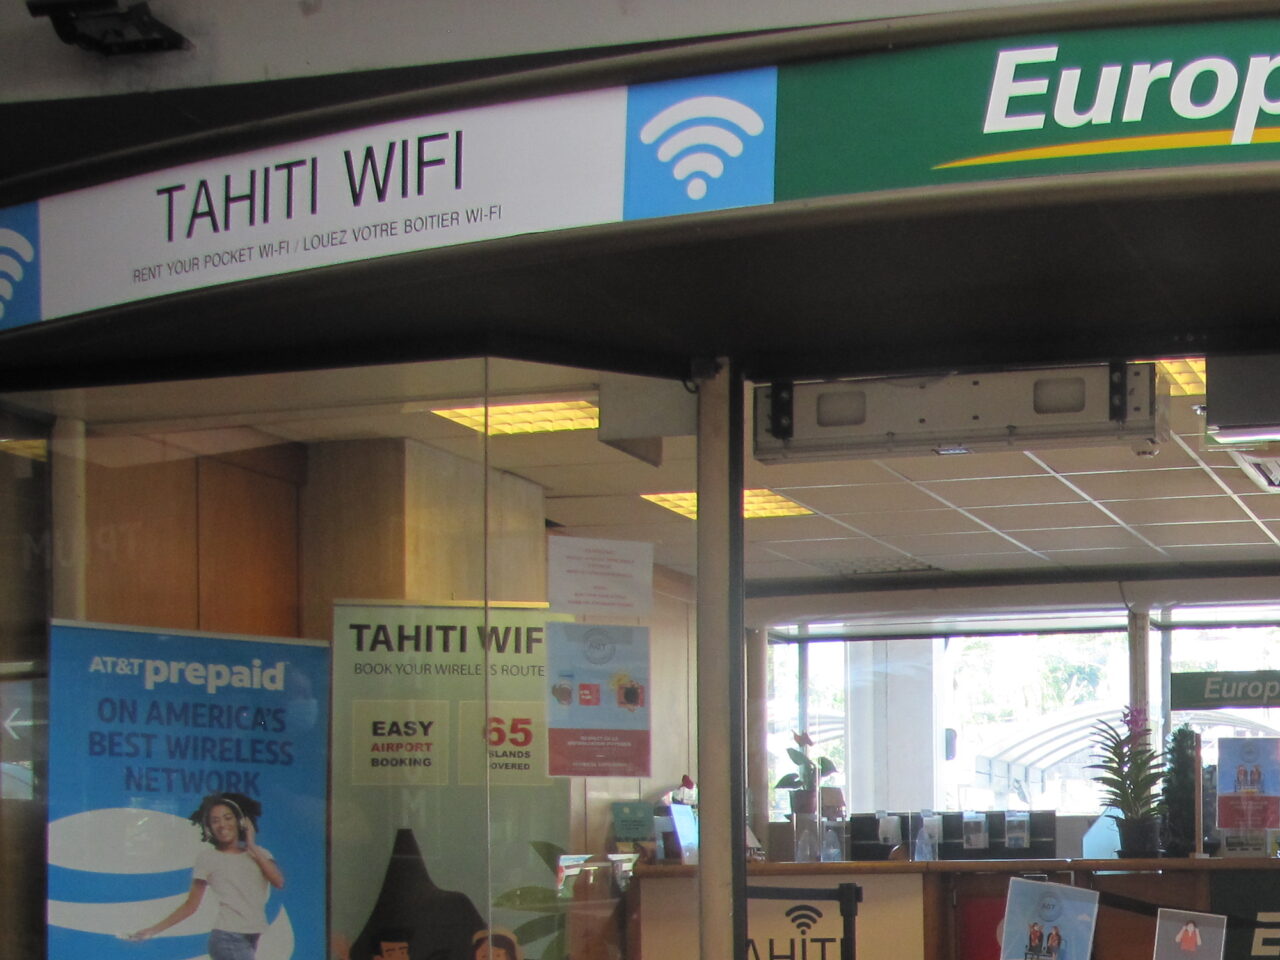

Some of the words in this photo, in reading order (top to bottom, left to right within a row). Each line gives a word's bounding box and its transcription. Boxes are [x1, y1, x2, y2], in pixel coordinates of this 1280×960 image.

[156, 156, 319, 243] TAHITI
[343, 130, 464, 207] WIFI
[132, 263, 163, 284] RENT
[166, 256, 200, 277] YOUR
[203, 246, 255, 269] POCKET
[258, 239, 291, 260] WI-FI
[302, 229, 348, 252] LOUEZ
[352, 220, 399, 244] VOTRE
[403, 210, 461, 235] BOITIER
[464, 203, 503, 225] WI-FI
[349, 623, 468, 653] TAHITI
[476, 625, 544, 654] WIF
[88, 656, 144, 676] AT&T
[144, 658, 286, 695] prepaid
[354, 662, 392, 676] BOOK
[395, 663, 432, 676] YOUR
[434, 664, 498, 677] WIRELES
[501, 664, 545, 677] ROUTE
[97, 697, 138, 724] ON
[145, 701, 287, 734] AMERICA'S
[371, 720, 435, 737] EASY
[370, 741, 434, 753] AIRPORT
[484, 716, 533, 748] 65
[88, 731, 158, 759] BEST
[165, 734, 295, 767] WIRELESS
[370, 757, 432, 768] BOOKING
[488, 750, 531, 759] SLANDS
[124, 766, 262, 797] NETWORK
[489, 762, 531, 771] OVERED
